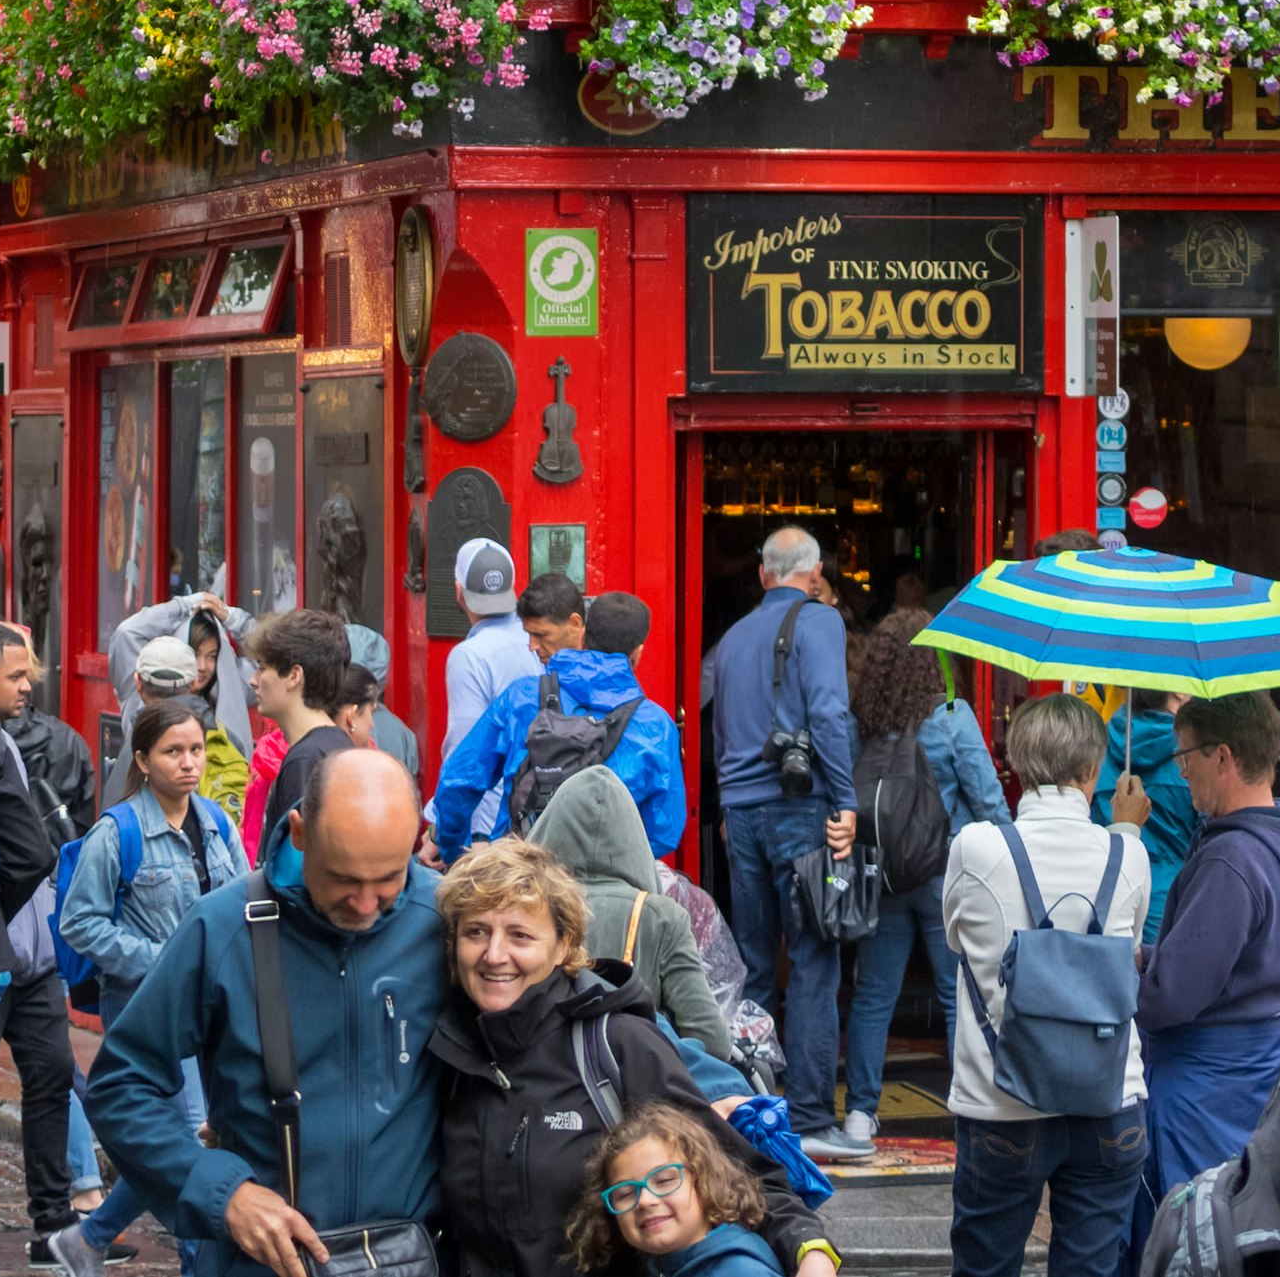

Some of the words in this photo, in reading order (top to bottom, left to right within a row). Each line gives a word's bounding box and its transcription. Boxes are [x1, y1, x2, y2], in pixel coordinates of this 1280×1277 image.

[704, 212, 842, 272] Importers
[791, 248, 816, 264] OF
[828, 260, 879, 280] FINE
[886, 260, 990, 281] SMOKING
[542, 303, 583, 313] Official
[741, 272, 991, 360] TOBACCO
[539, 314, 586, 324] Member
[793, 345, 887, 366] Always
[903, 347, 925, 364] in
[937, 345, 1011, 365] Stock
[544, 1115, 570, 1124] NORTH
